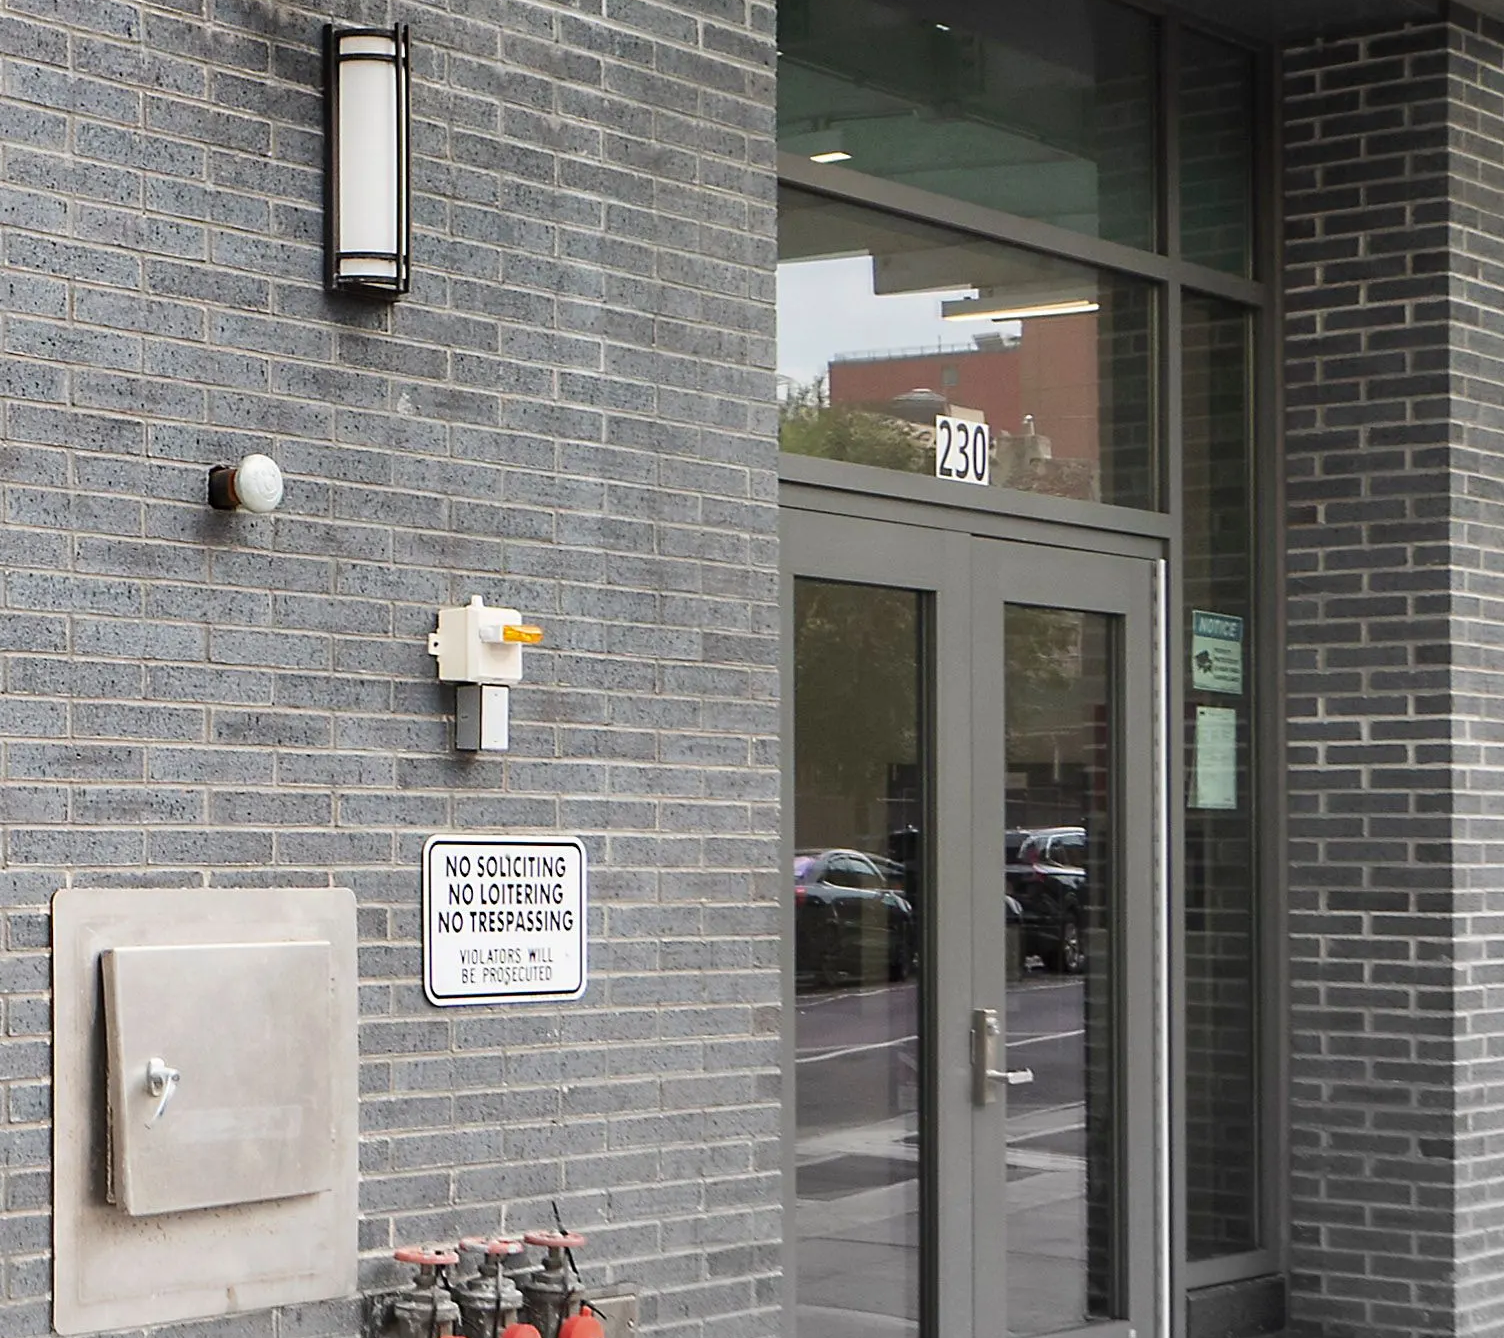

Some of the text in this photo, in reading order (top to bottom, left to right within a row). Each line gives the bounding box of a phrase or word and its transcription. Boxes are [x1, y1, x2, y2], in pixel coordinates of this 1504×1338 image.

[939, 419, 987, 482] 230
[1198, 616, 1238, 638] NOTICE
[445, 855, 567, 878] NO SOLICITING
[448, 883, 564, 906] NO LOITERING
[438, 910, 574, 933] NO TRESPASSING
[459, 948, 554, 965] VIOLATORS WILL
[461, 966, 552, 984] BE PROSECUTED
